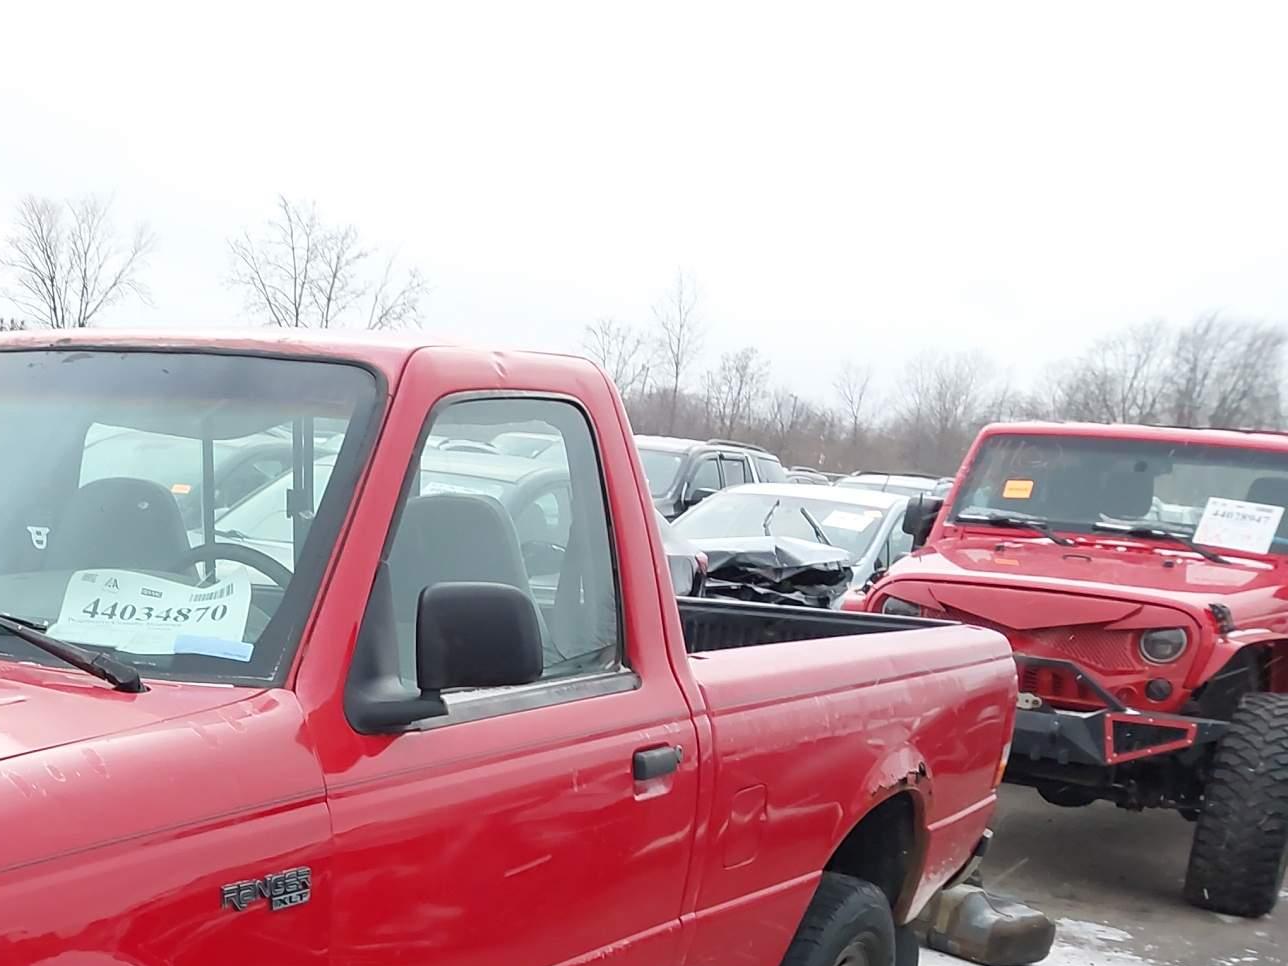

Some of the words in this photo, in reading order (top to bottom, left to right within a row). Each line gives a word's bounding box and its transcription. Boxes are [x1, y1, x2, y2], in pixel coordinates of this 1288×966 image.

[81, 597, 228, 623] 44034870
[221, 866, 311, 911] RANGER
[274, 892, 309, 909] XLT
